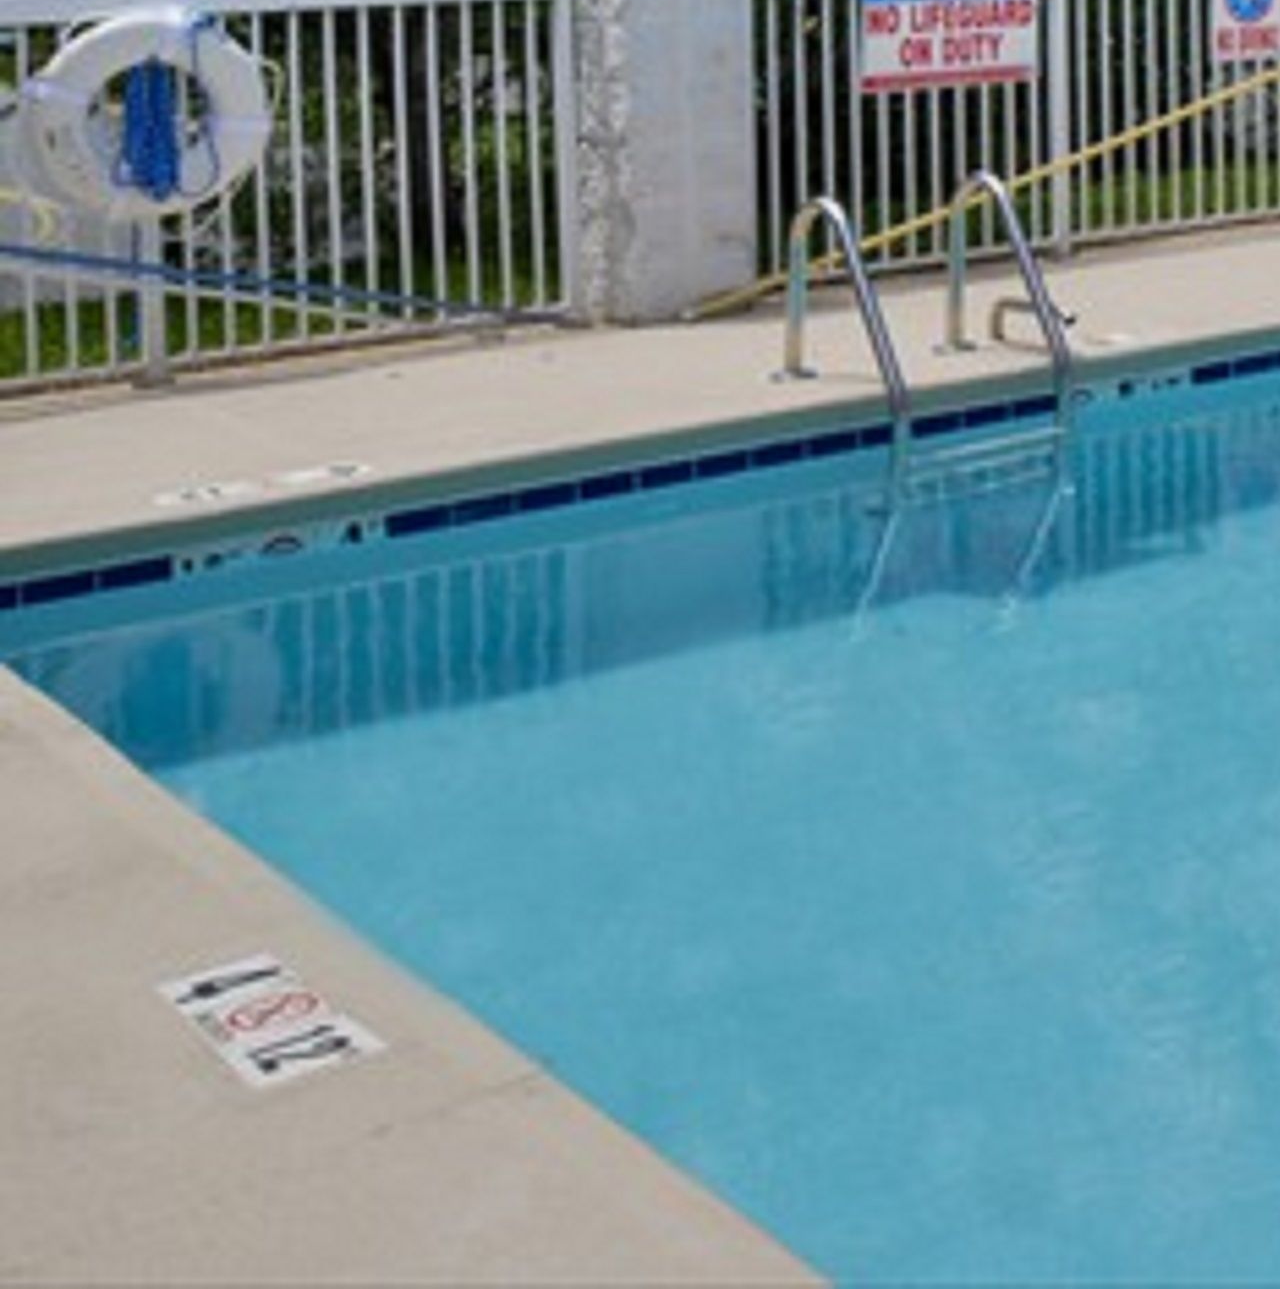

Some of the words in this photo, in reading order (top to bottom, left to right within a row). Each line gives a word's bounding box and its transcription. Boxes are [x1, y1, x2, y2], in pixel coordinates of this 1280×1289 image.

[868, 7, 898, 36] NO
[901, 36, 933, 68] ON
[943, 31, 1001, 65] DUTY
